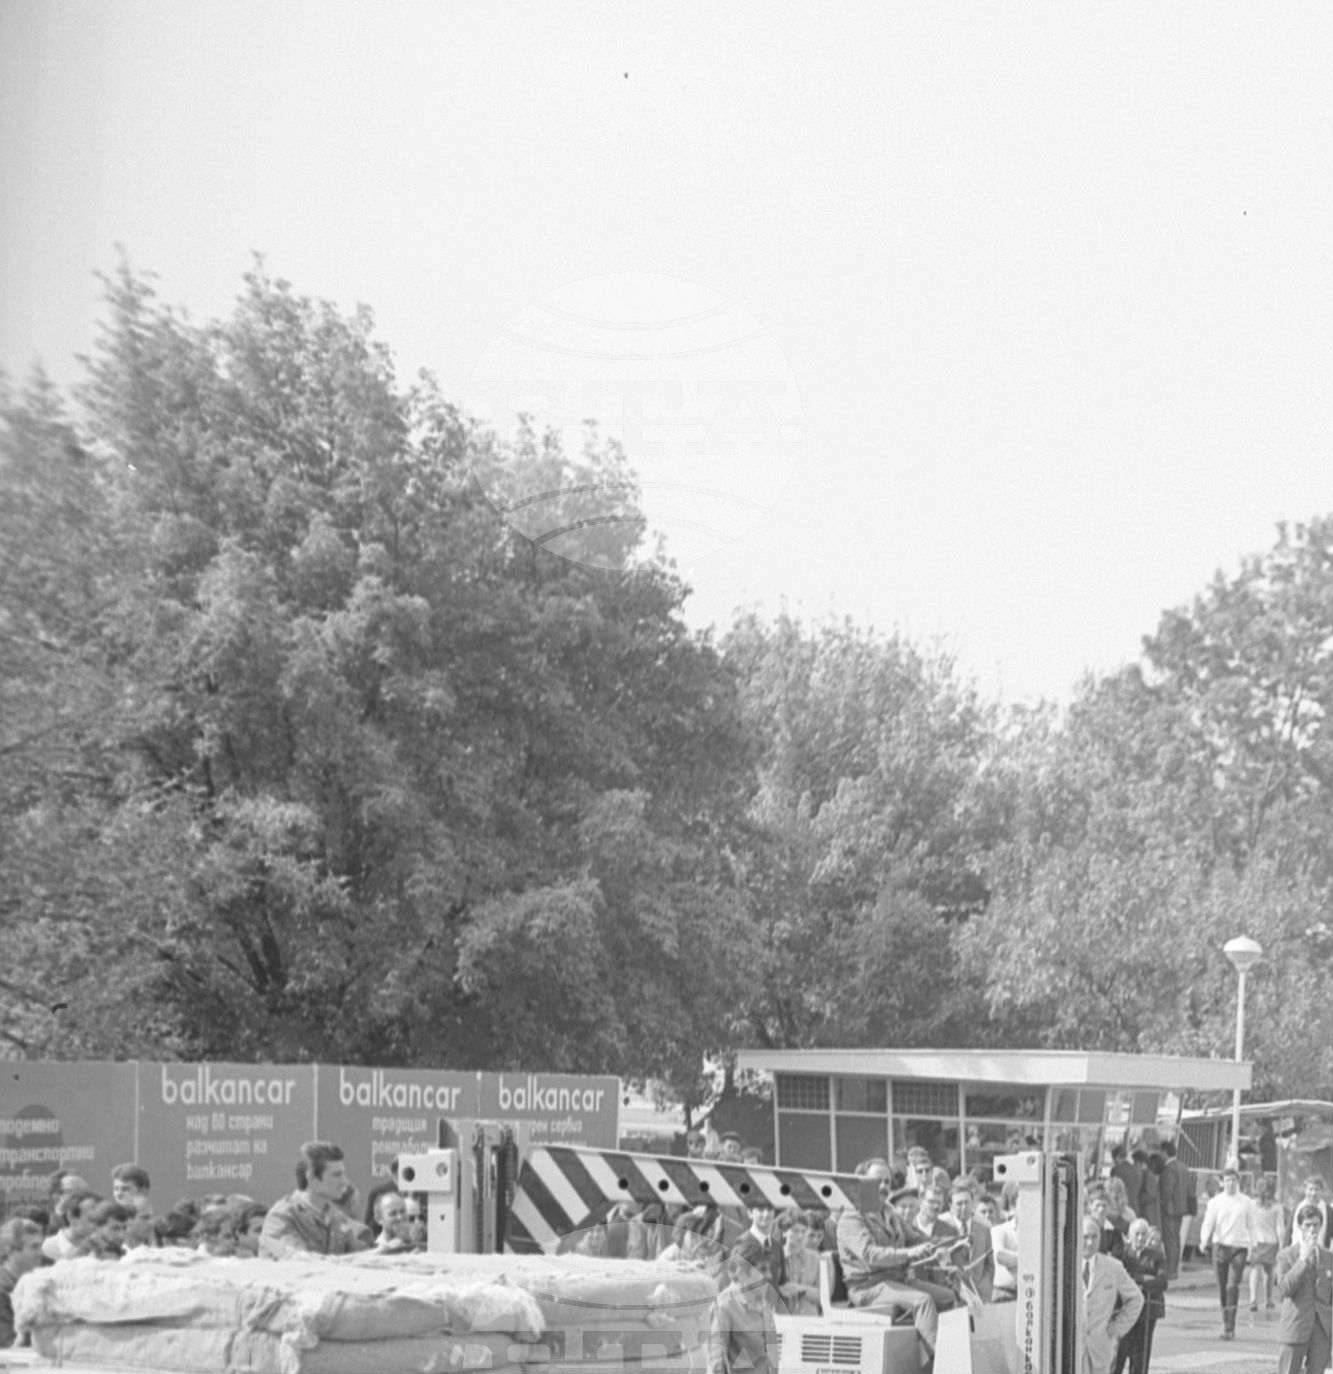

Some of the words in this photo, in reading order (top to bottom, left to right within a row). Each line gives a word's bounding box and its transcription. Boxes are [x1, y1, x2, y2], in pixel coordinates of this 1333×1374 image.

[162, 1065, 296, 1105] balkancar
[340, 1068, 461, 1110] balkancar
[499, 1075, 604, 1112] balkancar
[229, 1114, 274, 1134] страни
